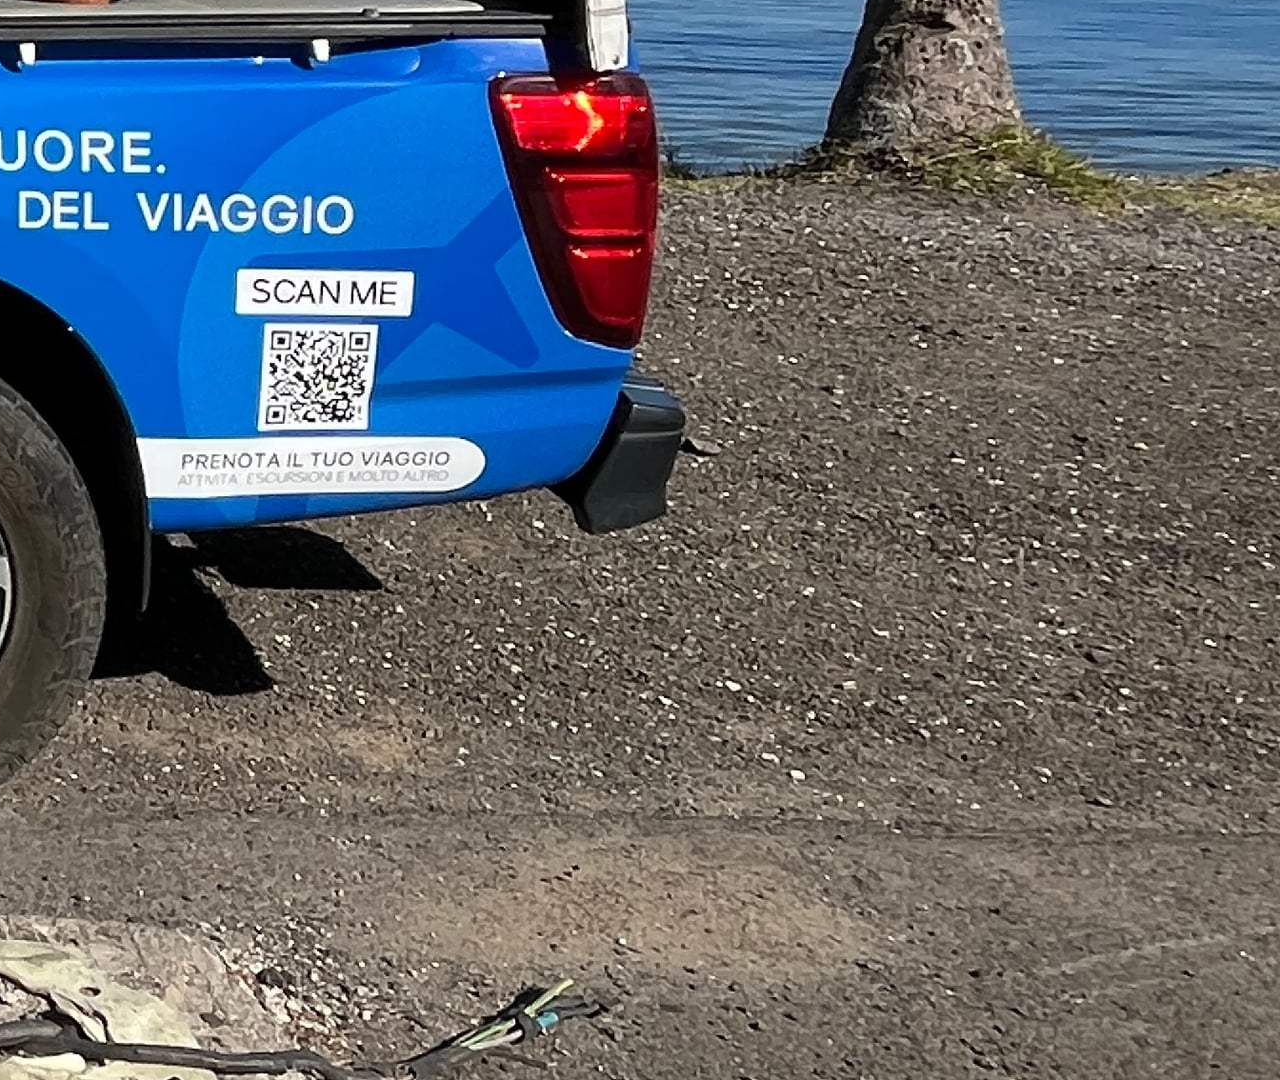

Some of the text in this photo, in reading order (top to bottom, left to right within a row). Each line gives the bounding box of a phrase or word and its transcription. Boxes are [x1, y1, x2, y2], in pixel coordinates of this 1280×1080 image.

[18, 189, 109, 229] DEL
[138, 192, 355, 235] VIAGGIO
[251, 277, 398, 306] SCAN ME
[181, 451, 451, 470] PRENOTA IL TUO VIAGGIO
[336, 470, 345, 482] E
[348, 469, 400, 482] MOLTO
[402, 469, 450, 481] ALTRO
